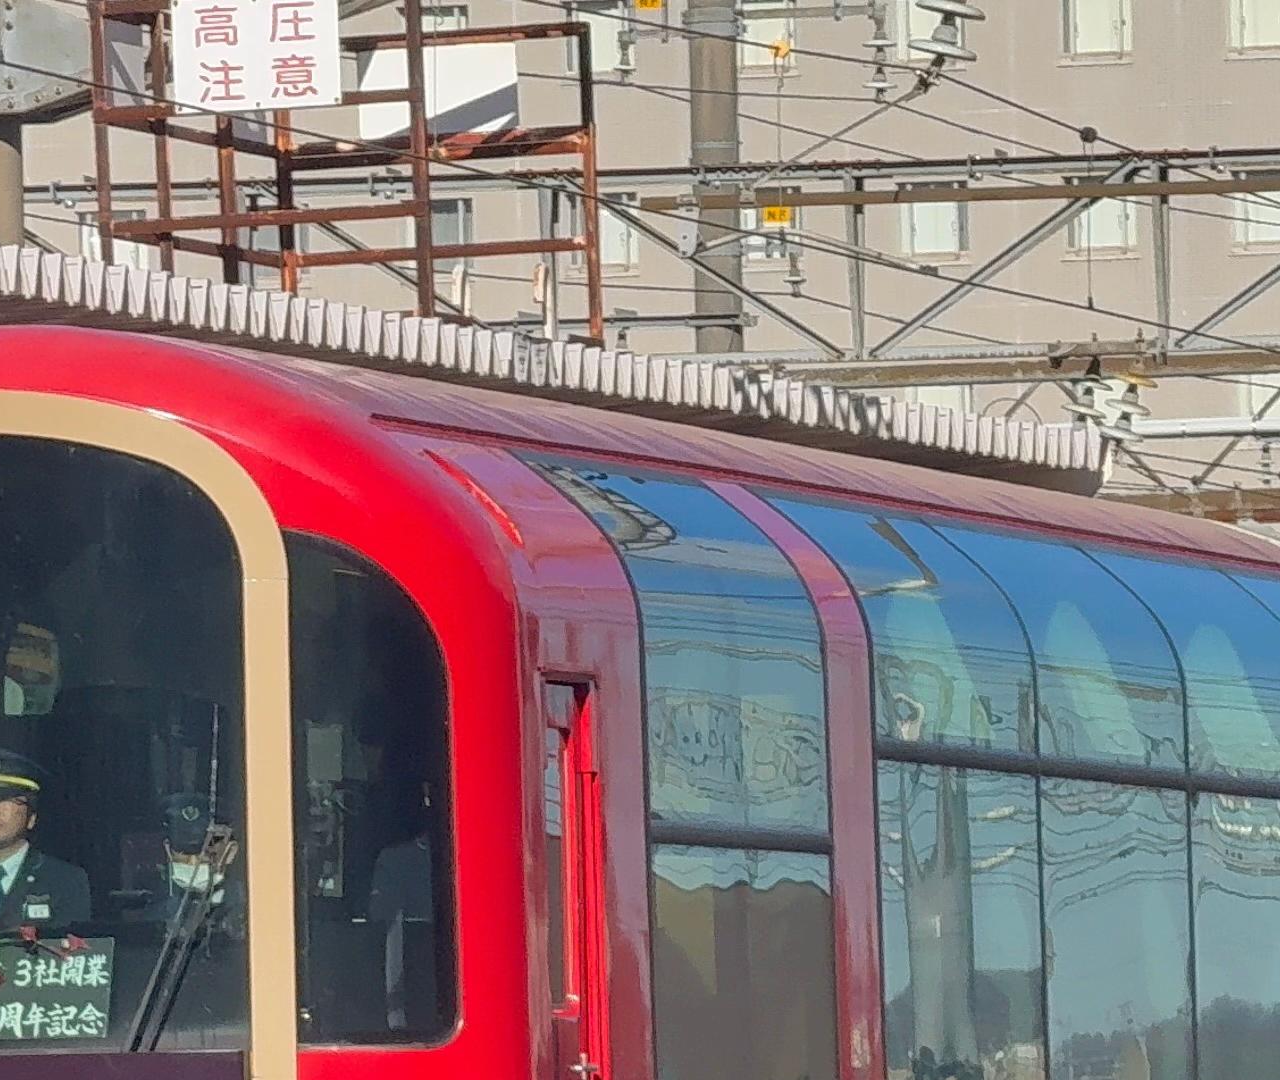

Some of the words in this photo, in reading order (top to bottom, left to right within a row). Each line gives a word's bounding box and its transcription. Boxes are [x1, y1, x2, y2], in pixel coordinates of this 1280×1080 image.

[194, 2, 316, 48] 高圧
[200, 54, 319, 103] 注意
[14, 954, 109, 987] 3社開業
